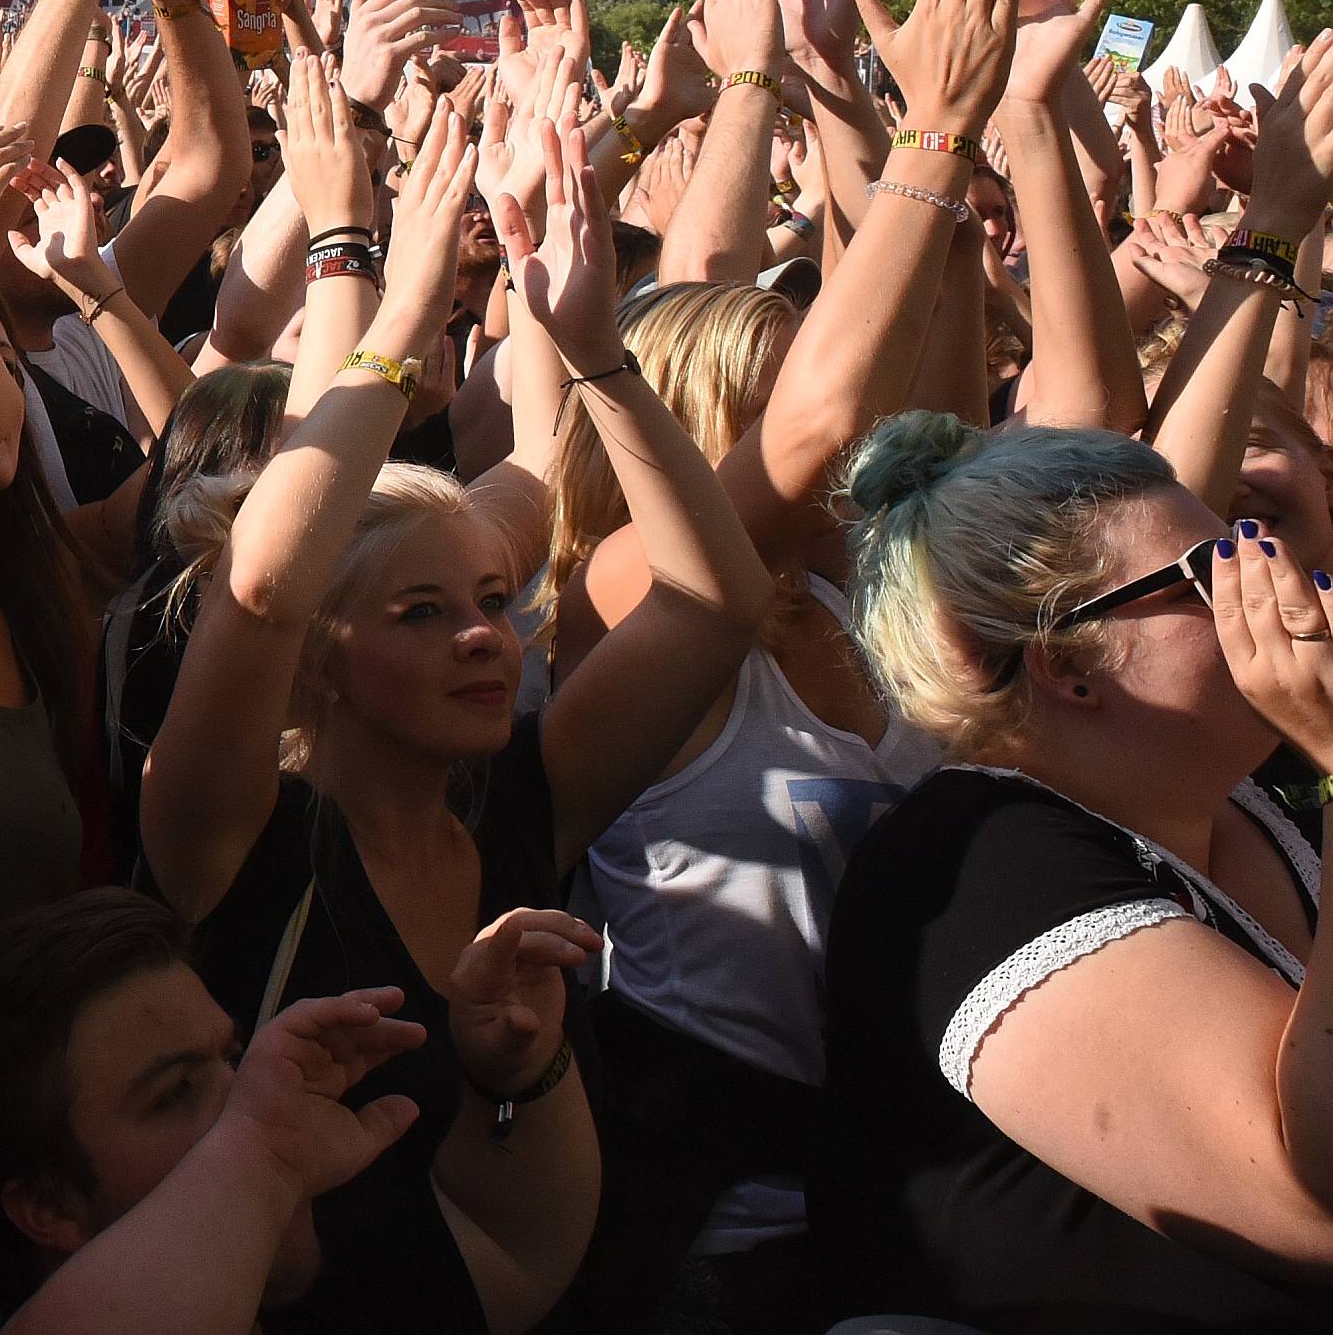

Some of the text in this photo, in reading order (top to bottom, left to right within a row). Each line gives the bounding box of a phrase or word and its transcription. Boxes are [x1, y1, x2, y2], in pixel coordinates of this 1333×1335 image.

[237, 8, 277, 34] Sangria
[734, 71, 773, 87] 2018
[923, 132, 946, 151] OF
